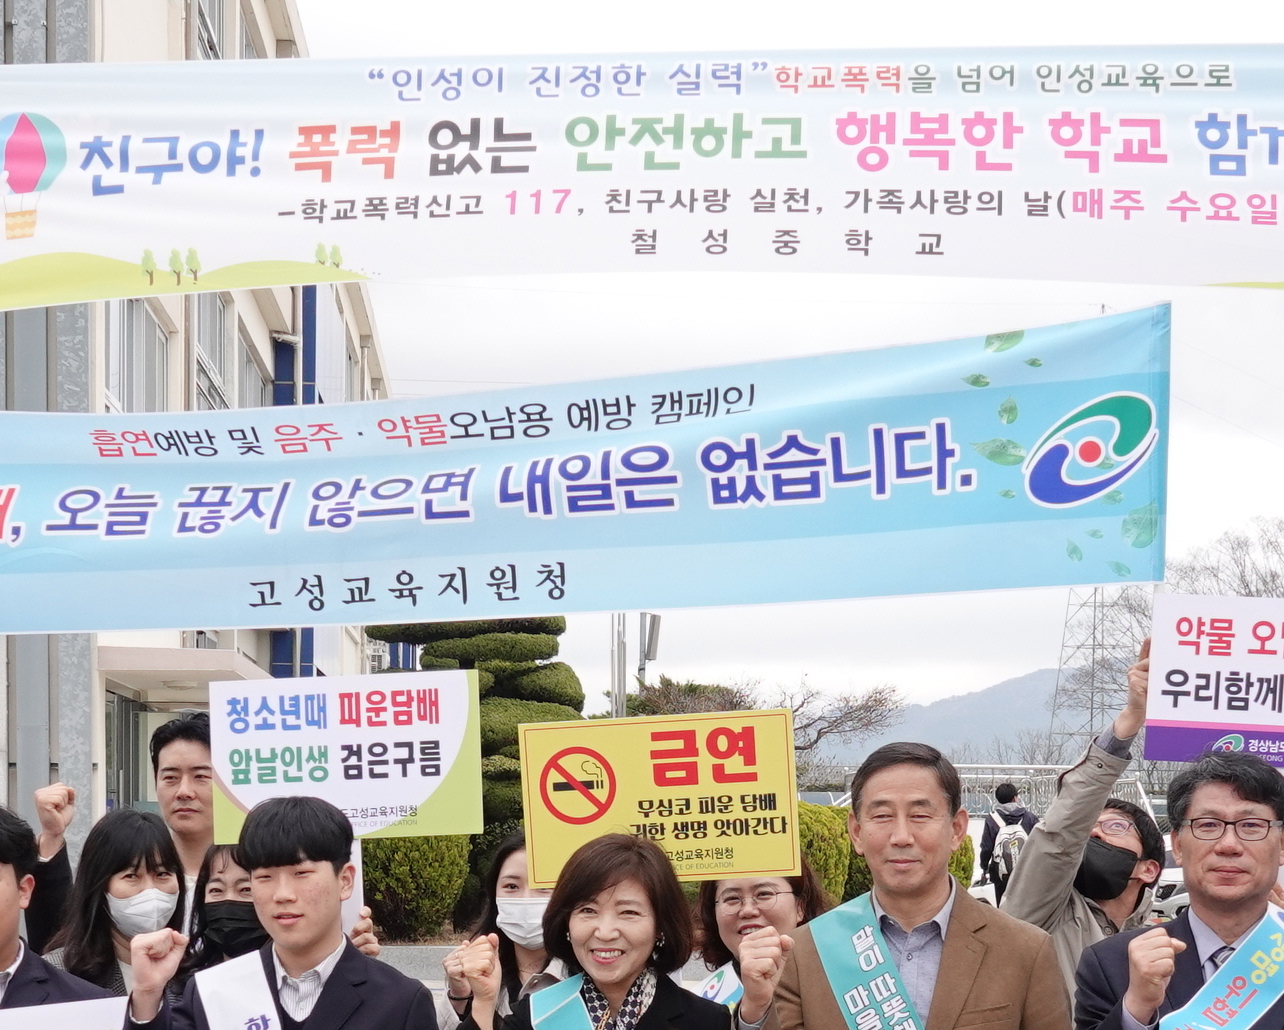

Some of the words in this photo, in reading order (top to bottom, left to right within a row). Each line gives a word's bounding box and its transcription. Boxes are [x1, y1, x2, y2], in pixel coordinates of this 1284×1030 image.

[528, 62, 648, 99] 진정한
[955, 64, 1018, 95] 넘어
[1034, 63, 1235, 95] 인성교육으로
[77, 127, 267, 199] 친구야!
[287, 117, 403, 185] 폭력
[426, 117, 538, 178] 없는
[565, 112, 809, 172] 안전하고
[834, 110, 1024, 174] 행복한
[1047, 110, 1168, 171] 학교
[604, 186, 732, 217] 친구사랑
[749, 186, 823, 219] 실천,
[843, 187, 1005, 218] 가족사랑의
[89, 426, 217, 460] 흡연예방
[227, 424, 264, 458] 및
[566, 396, 637, 433] 예방
[650, 383, 757, 427] 캠페인
[45, 485, 155, 537] 오늘
[175, 481, 289, 537] 끊지
[307, 466, 479, 532] 않으면
[498, 444, 679, 517] 내일은
[698, 419, 975, 507] 없습니다.
[1175, 616, 1236, 657] 약물
[226, 694, 328, 734] 청소년때
[338, 688, 439, 728] 피운담배
[1161, 668, 1284, 714] 우리함께
[229, 745, 329, 785] 앞날인생
[340, 740, 442, 780] 검은구름
[650, 726, 758, 787] 금연
[637, 797, 692, 818] 무심코
[698, 795, 734, 815] 피운
[739, 792, 777, 812] 담배
[671, 819, 708, 840] 생명
[713, 816, 788, 837] 앗아간다
